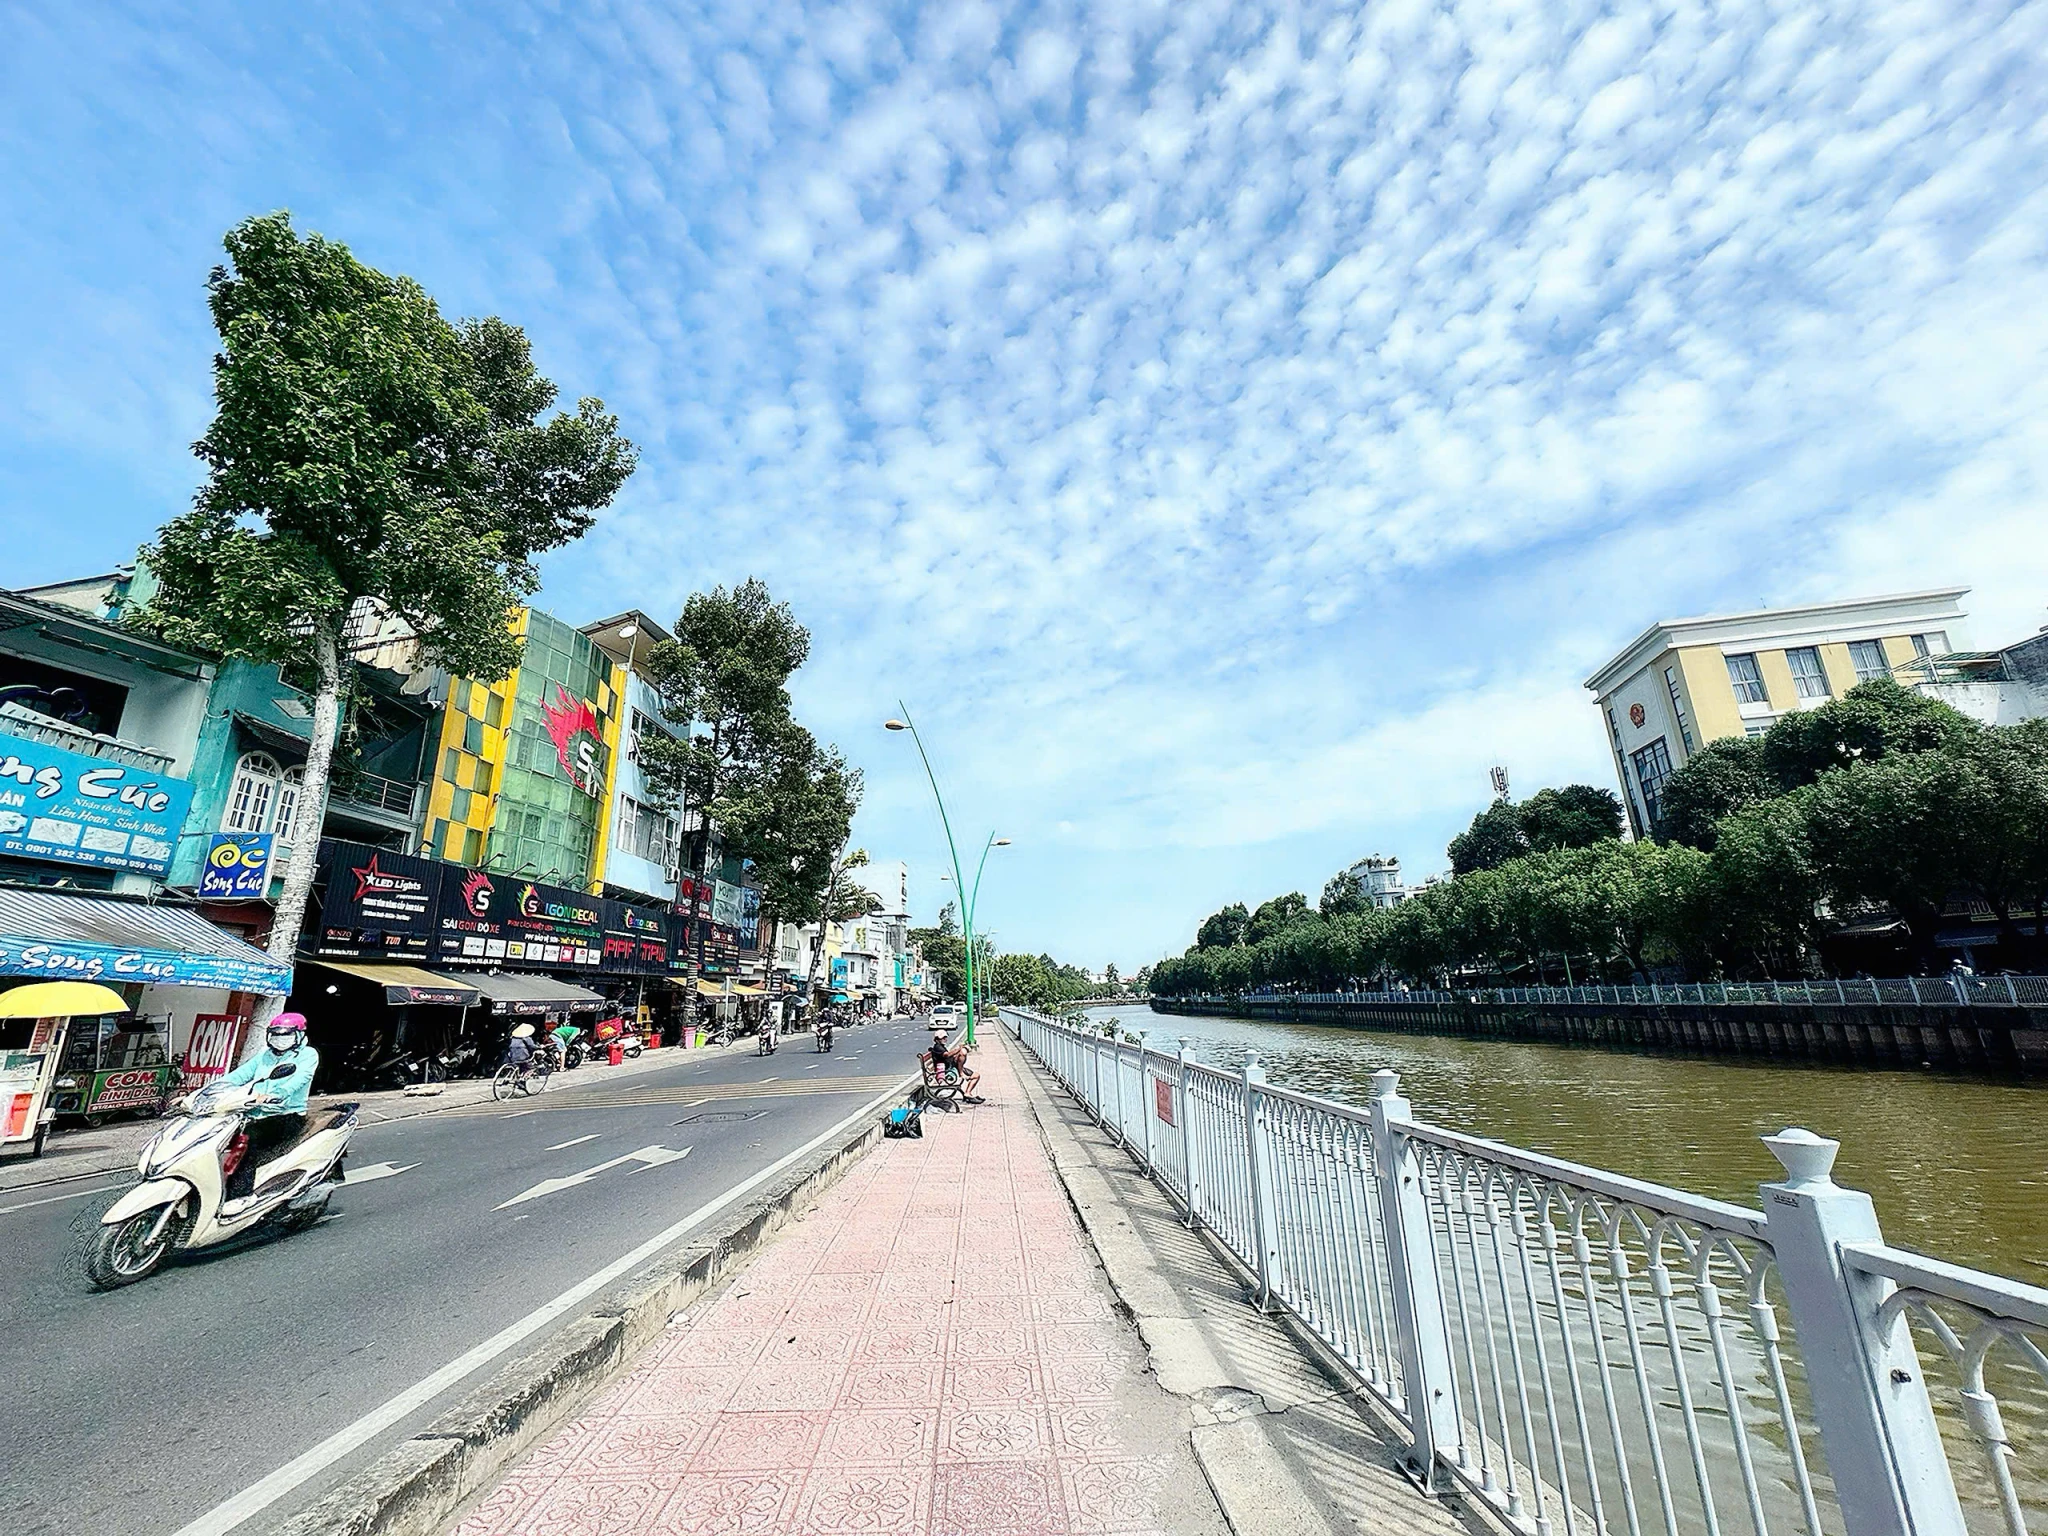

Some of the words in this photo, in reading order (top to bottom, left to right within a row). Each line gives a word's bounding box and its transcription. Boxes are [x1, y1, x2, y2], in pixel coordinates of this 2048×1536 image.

[0, 755, 62, 799] ng
[78, 768, 170, 813] Cúc
[114, 818, 140, 831] Sinh
[25, 843, 52, 855] 0901
[103, 855, 127, 867] 0909
[203, 870, 234, 897] Song
[236, 869, 263, 891] Cúc
[374, 878, 393, 888] LED
[394, 880, 422, 892] Lights
[475, 890, 492, 911] S
[21, 945, 104, 980] Song
[114, 954, 176, 978] Cúc
[190, 1020, 232, 1068] CƠM
[104, 1069, 158, 1089] CƠM
[97, 1089, 133, 1103] BÌNH
[131, 1085, 159, 1099] DÂN
